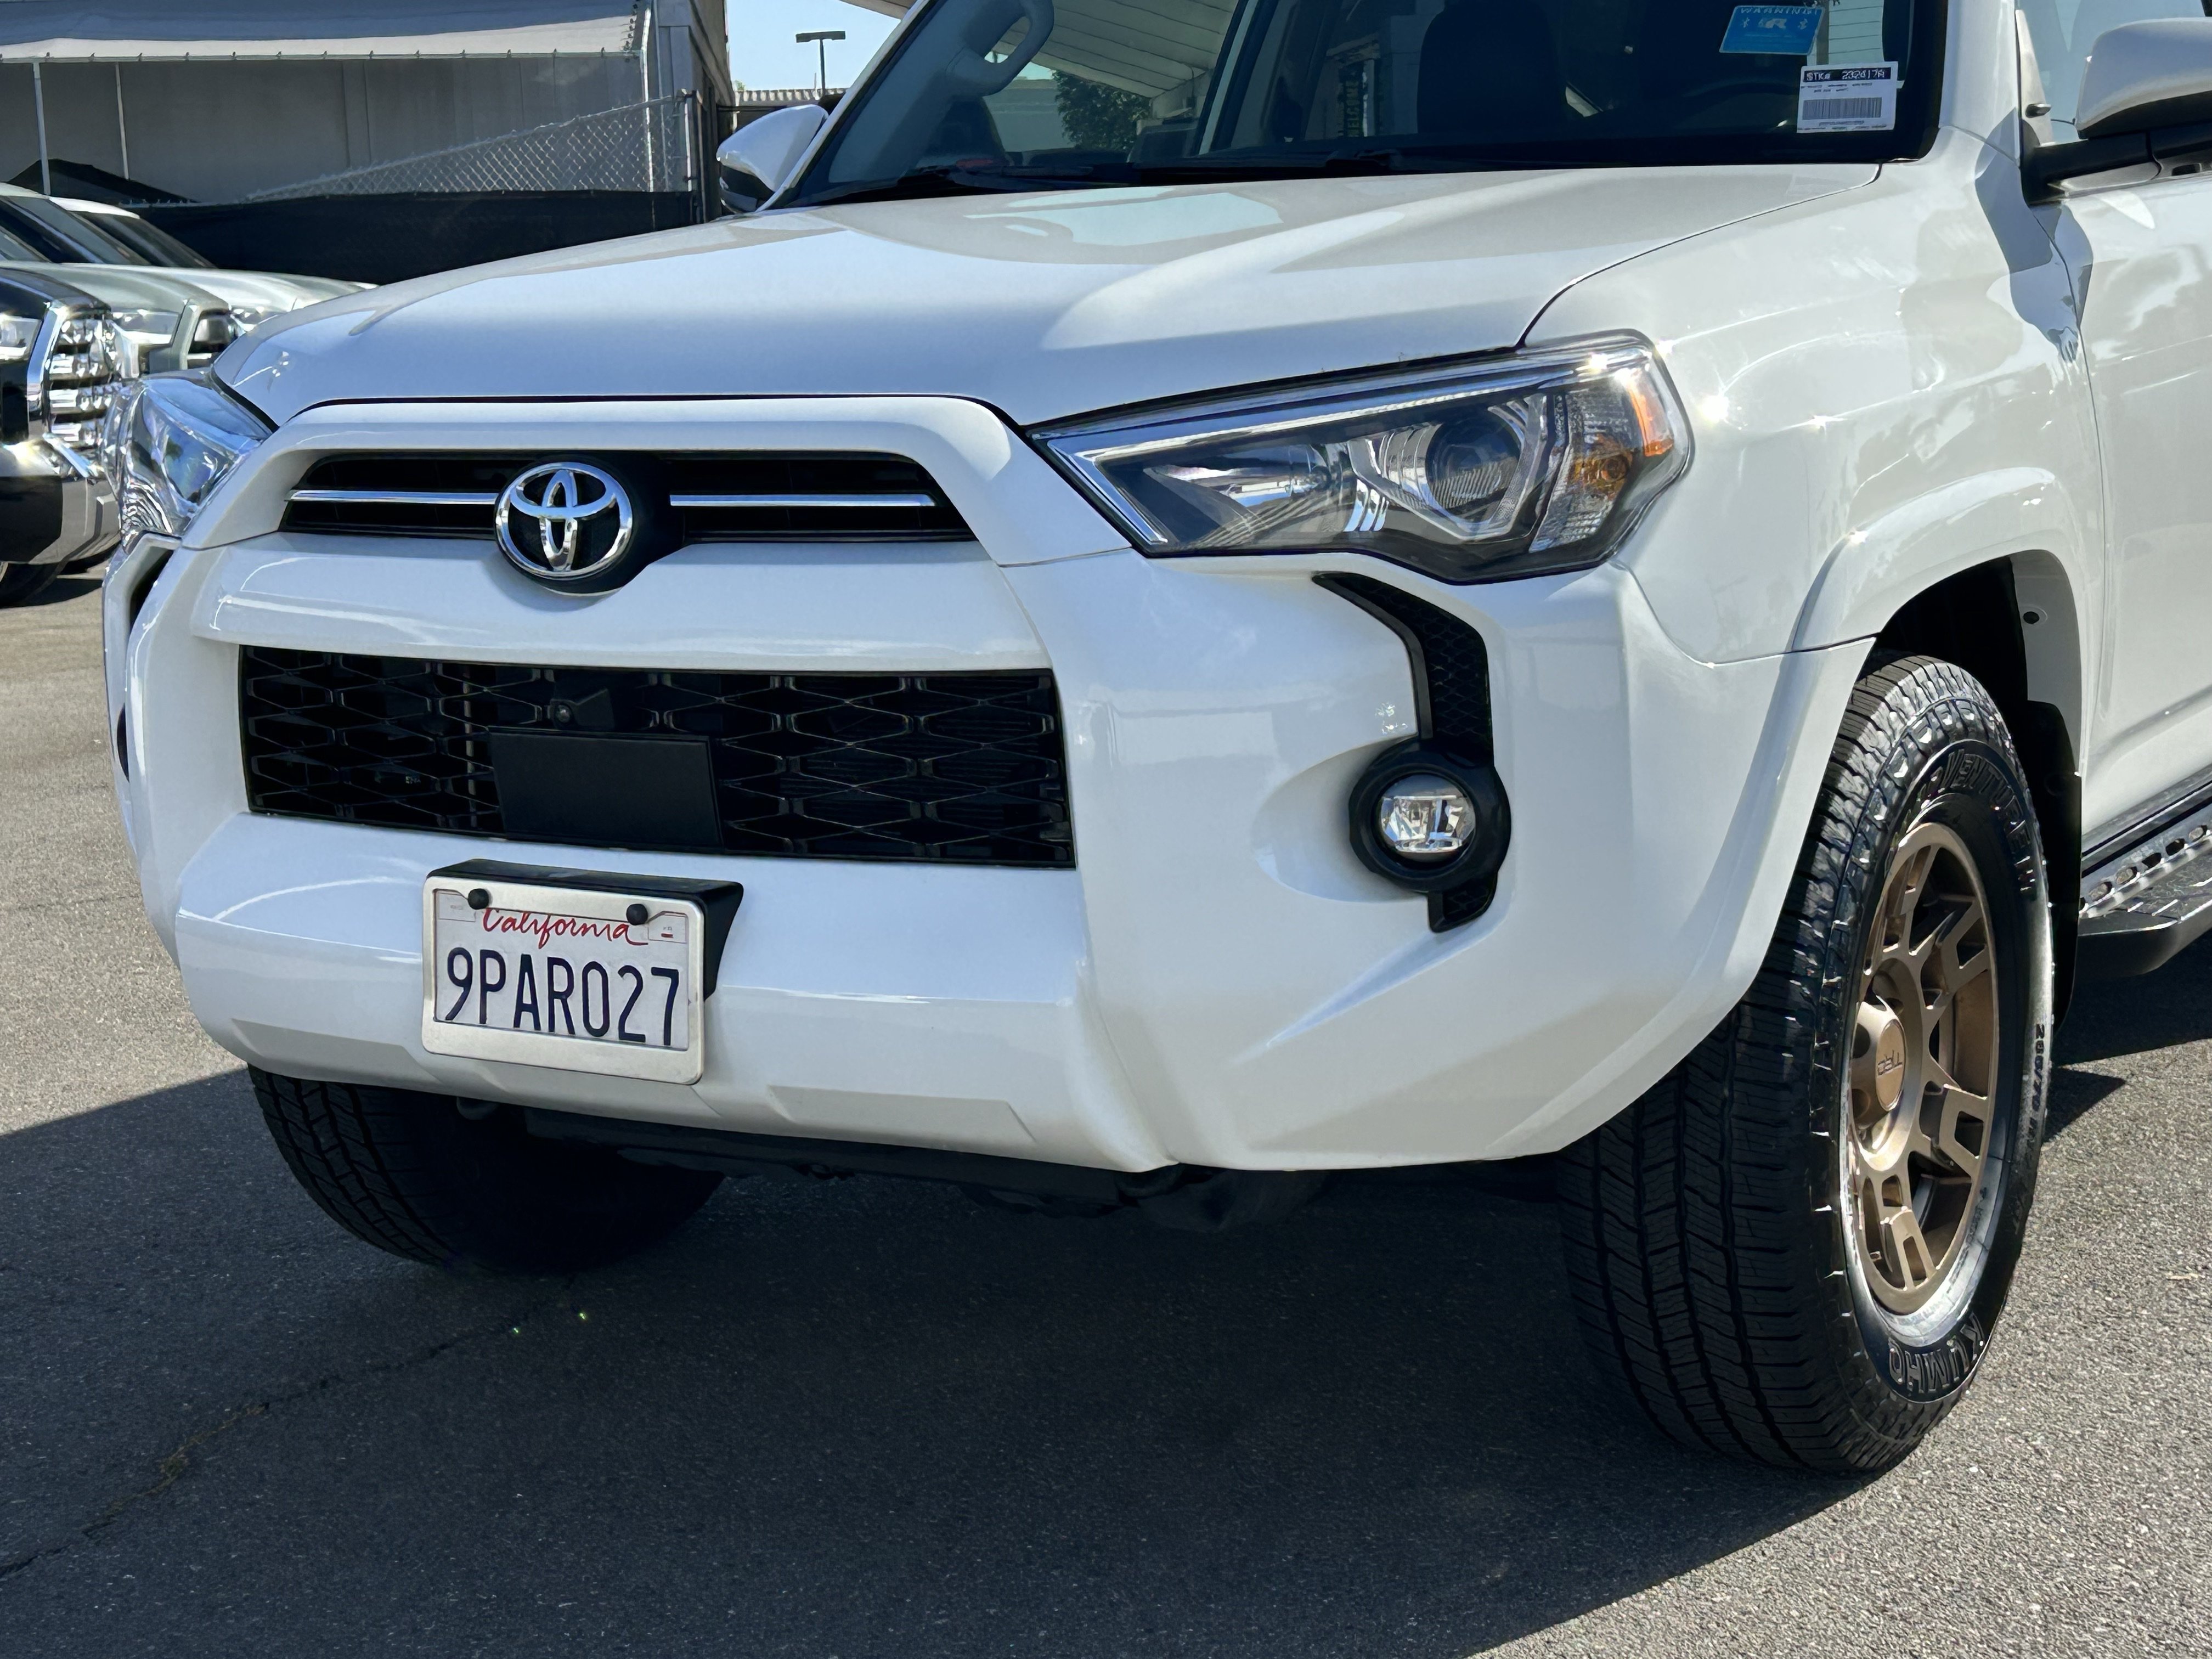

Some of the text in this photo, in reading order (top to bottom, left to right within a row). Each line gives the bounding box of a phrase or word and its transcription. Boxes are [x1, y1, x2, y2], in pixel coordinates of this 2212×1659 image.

[482, 907, 649, 950] California
[445, 947, 680, 1046] 9PAR027
[1877, 1049, 1903, 1076] TRD
[1888, 1312, 1985, 1395] KUMHO
